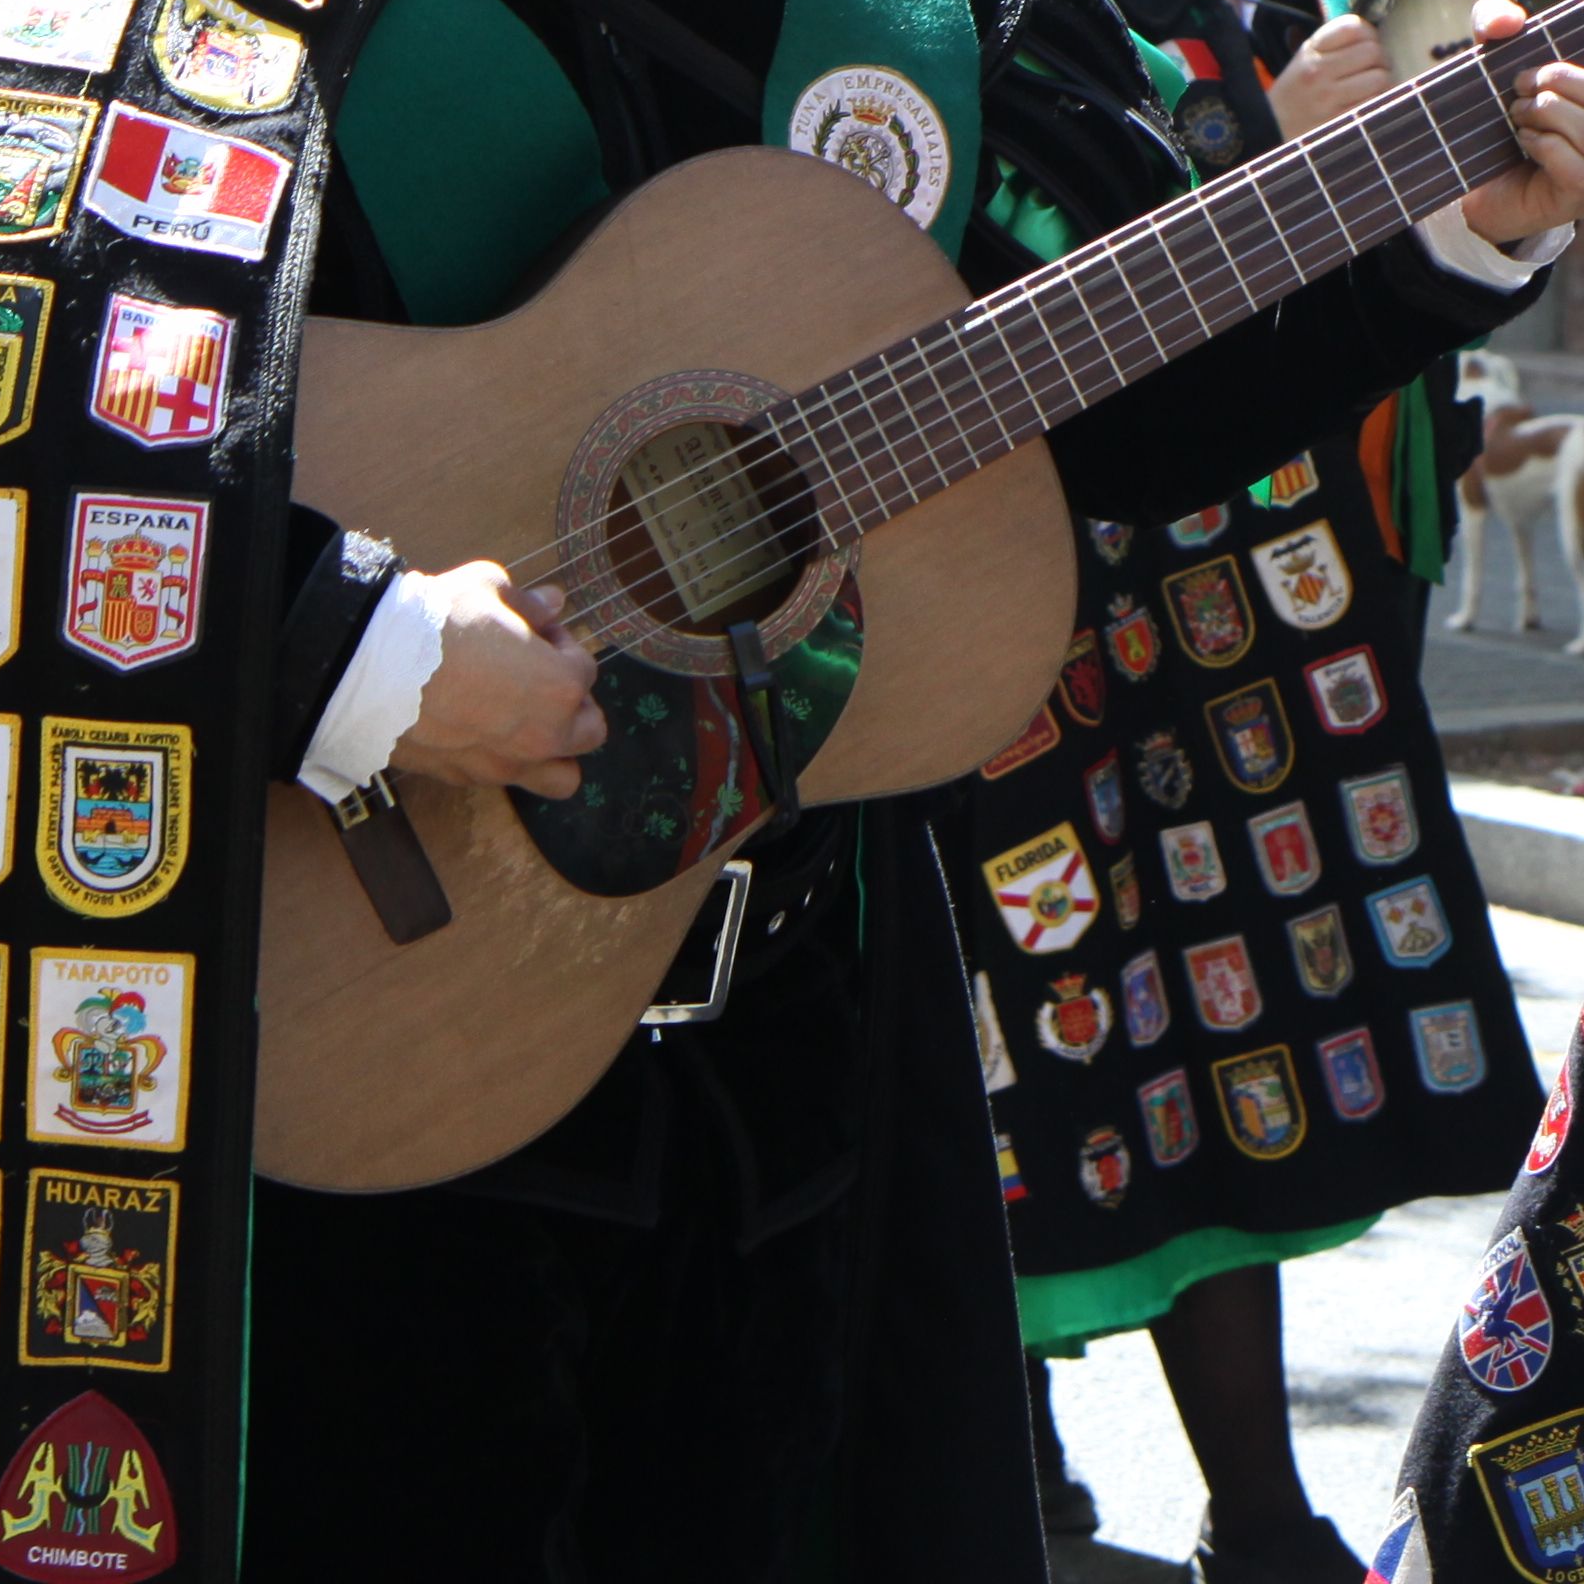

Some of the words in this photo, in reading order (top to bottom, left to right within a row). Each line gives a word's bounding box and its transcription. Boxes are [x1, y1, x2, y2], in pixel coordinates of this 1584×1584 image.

[795, 91, 827, 137] TUNA
[843, 73, 942, 189] EMPRESARIALES
[131, 213, 212, 242] PERÚ
[89, 509, 190, 532] ESPAÑA
[994, 836, 1069, 883] FLORIDA
[52, 960, 171, 987] TARAPOTO
[45, 1179, 164, 1214] HUARAZ
[27, 1545, 129, 1571] CHIMBOTE
